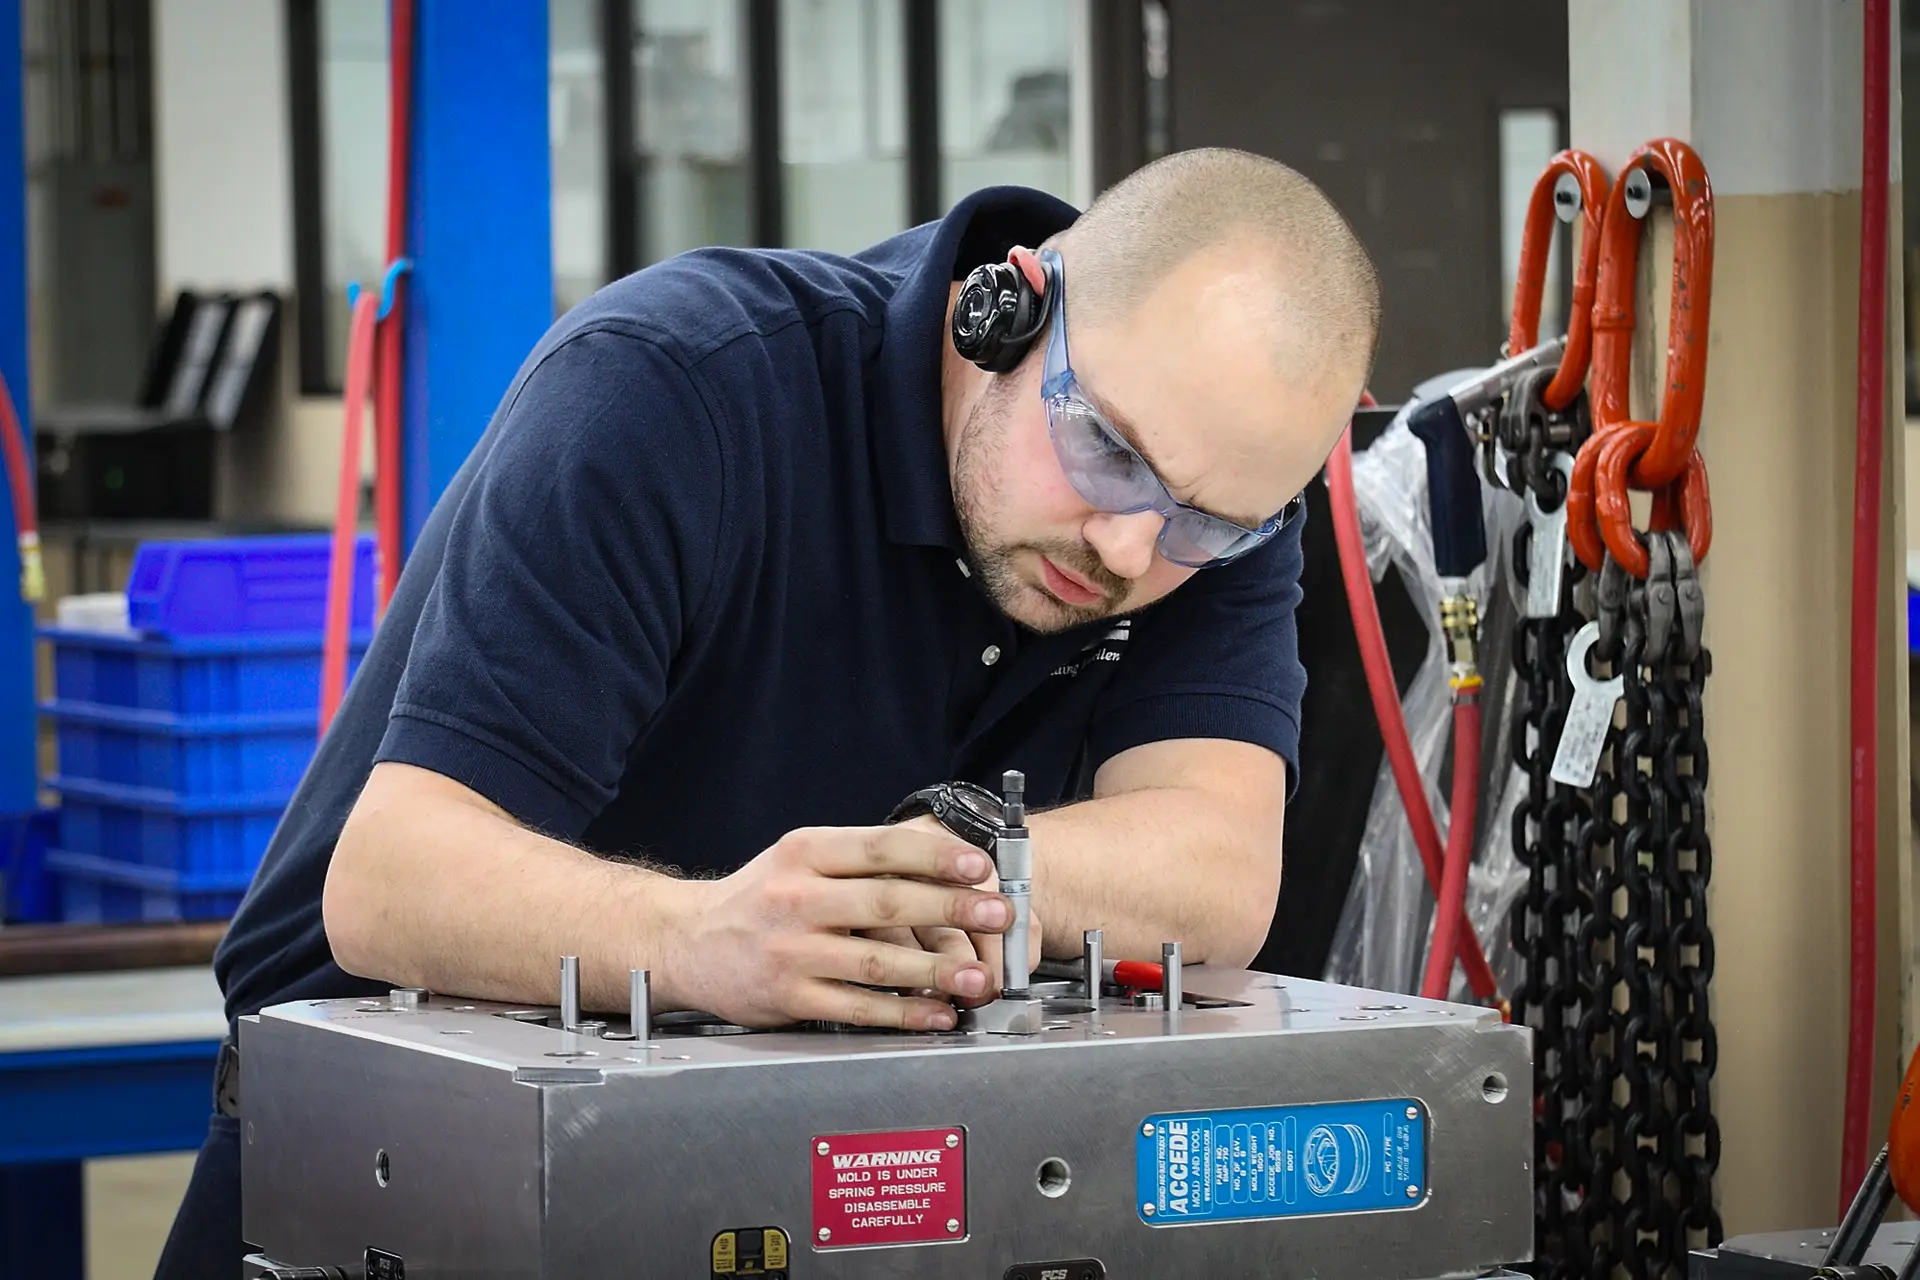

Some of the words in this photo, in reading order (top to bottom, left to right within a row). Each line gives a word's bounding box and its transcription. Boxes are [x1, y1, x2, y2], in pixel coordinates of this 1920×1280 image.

[1191, 1128, 1200, 1153] TOOL
[832, 1150, 942, 1169] WARNING
[1168, 1121, 1188, 1214] ACCEDE
[1191, 1156, 1200, 1177] AND
[1233, 1161, 1240, 1172] OF
[837, 1171, 871, 1183] MOLD
[878, 1170, 891, 1180] IS
[897, 1167, 938, 1179] UNDER
[829, 1186, 875, 1199] SPRING
[881, 1182, 946, 1196] PRESSURE
[1191, 1180, 1200, 1208] MOLD
[845, 1198, 931, 1213] DISASSEMBLE
[852, 1214, 924, 1228] CAREFULLY
